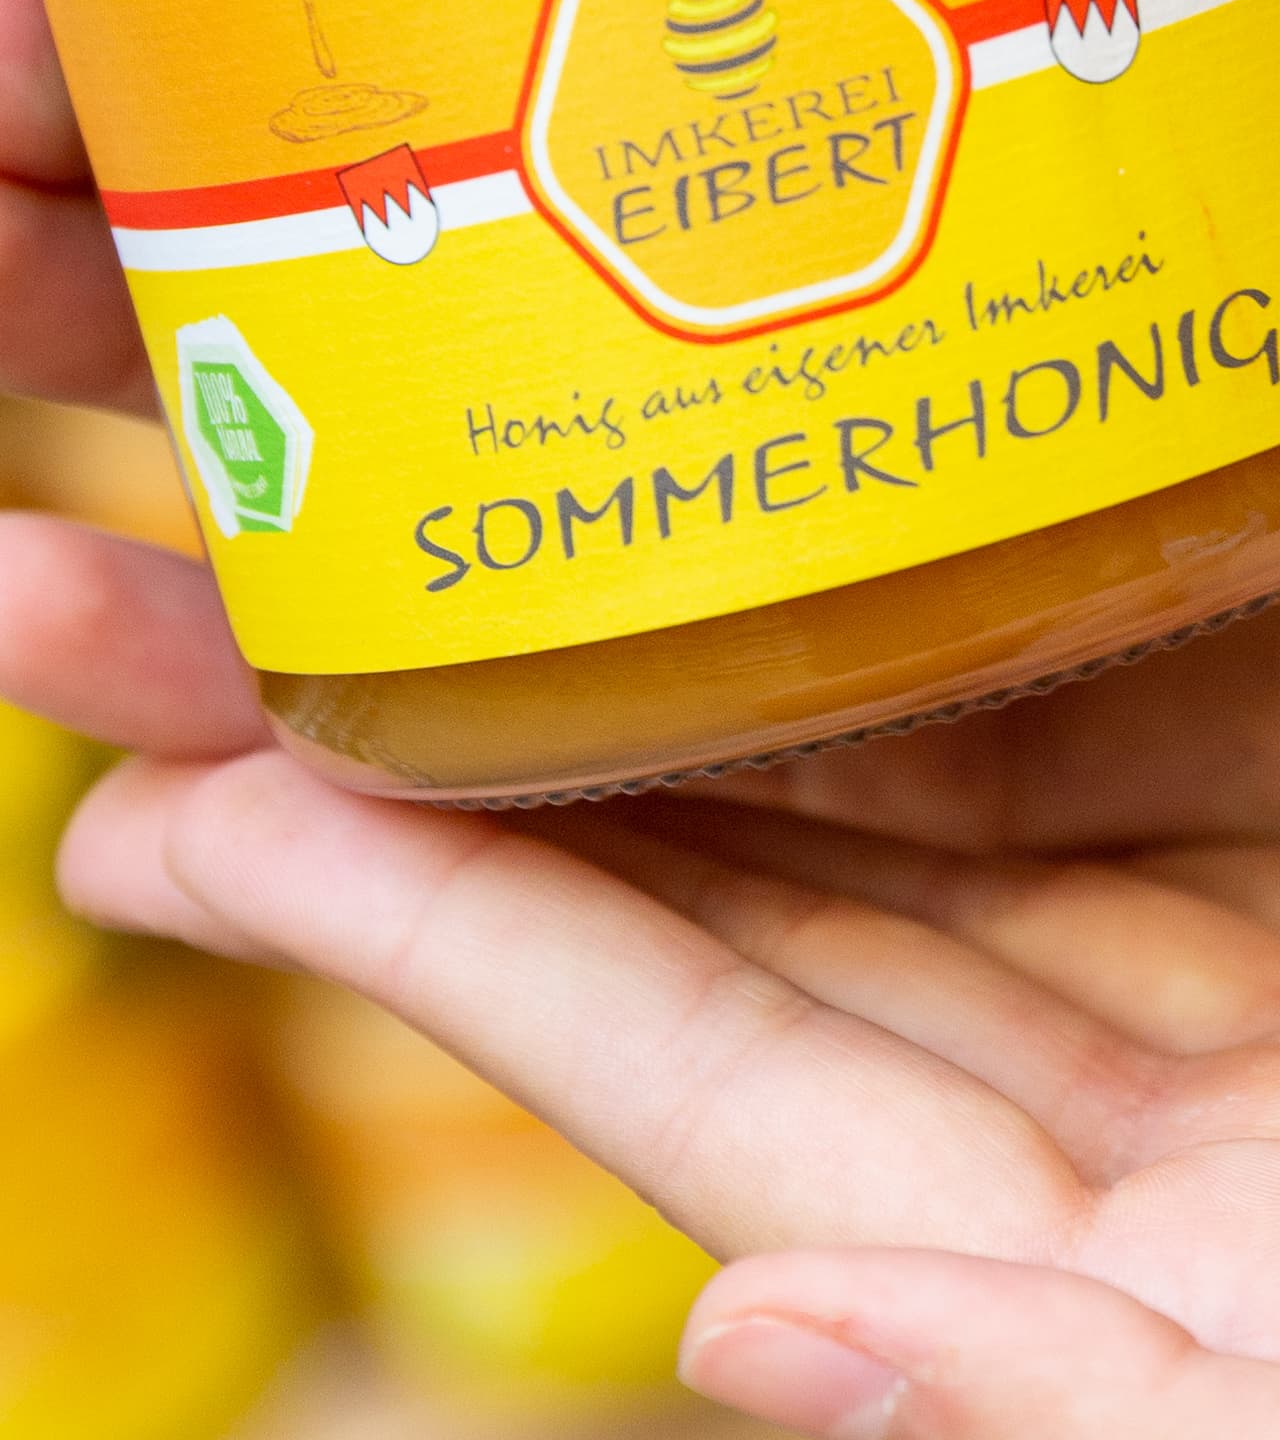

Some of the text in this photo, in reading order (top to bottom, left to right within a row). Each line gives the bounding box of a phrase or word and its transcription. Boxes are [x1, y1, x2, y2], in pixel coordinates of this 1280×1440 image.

[593, 65, 904, 182] IMKEREI
[612, 111, 917, 246] EIBERT
[465, 230, 1166, 456] Honig aus eigener Imkerei
